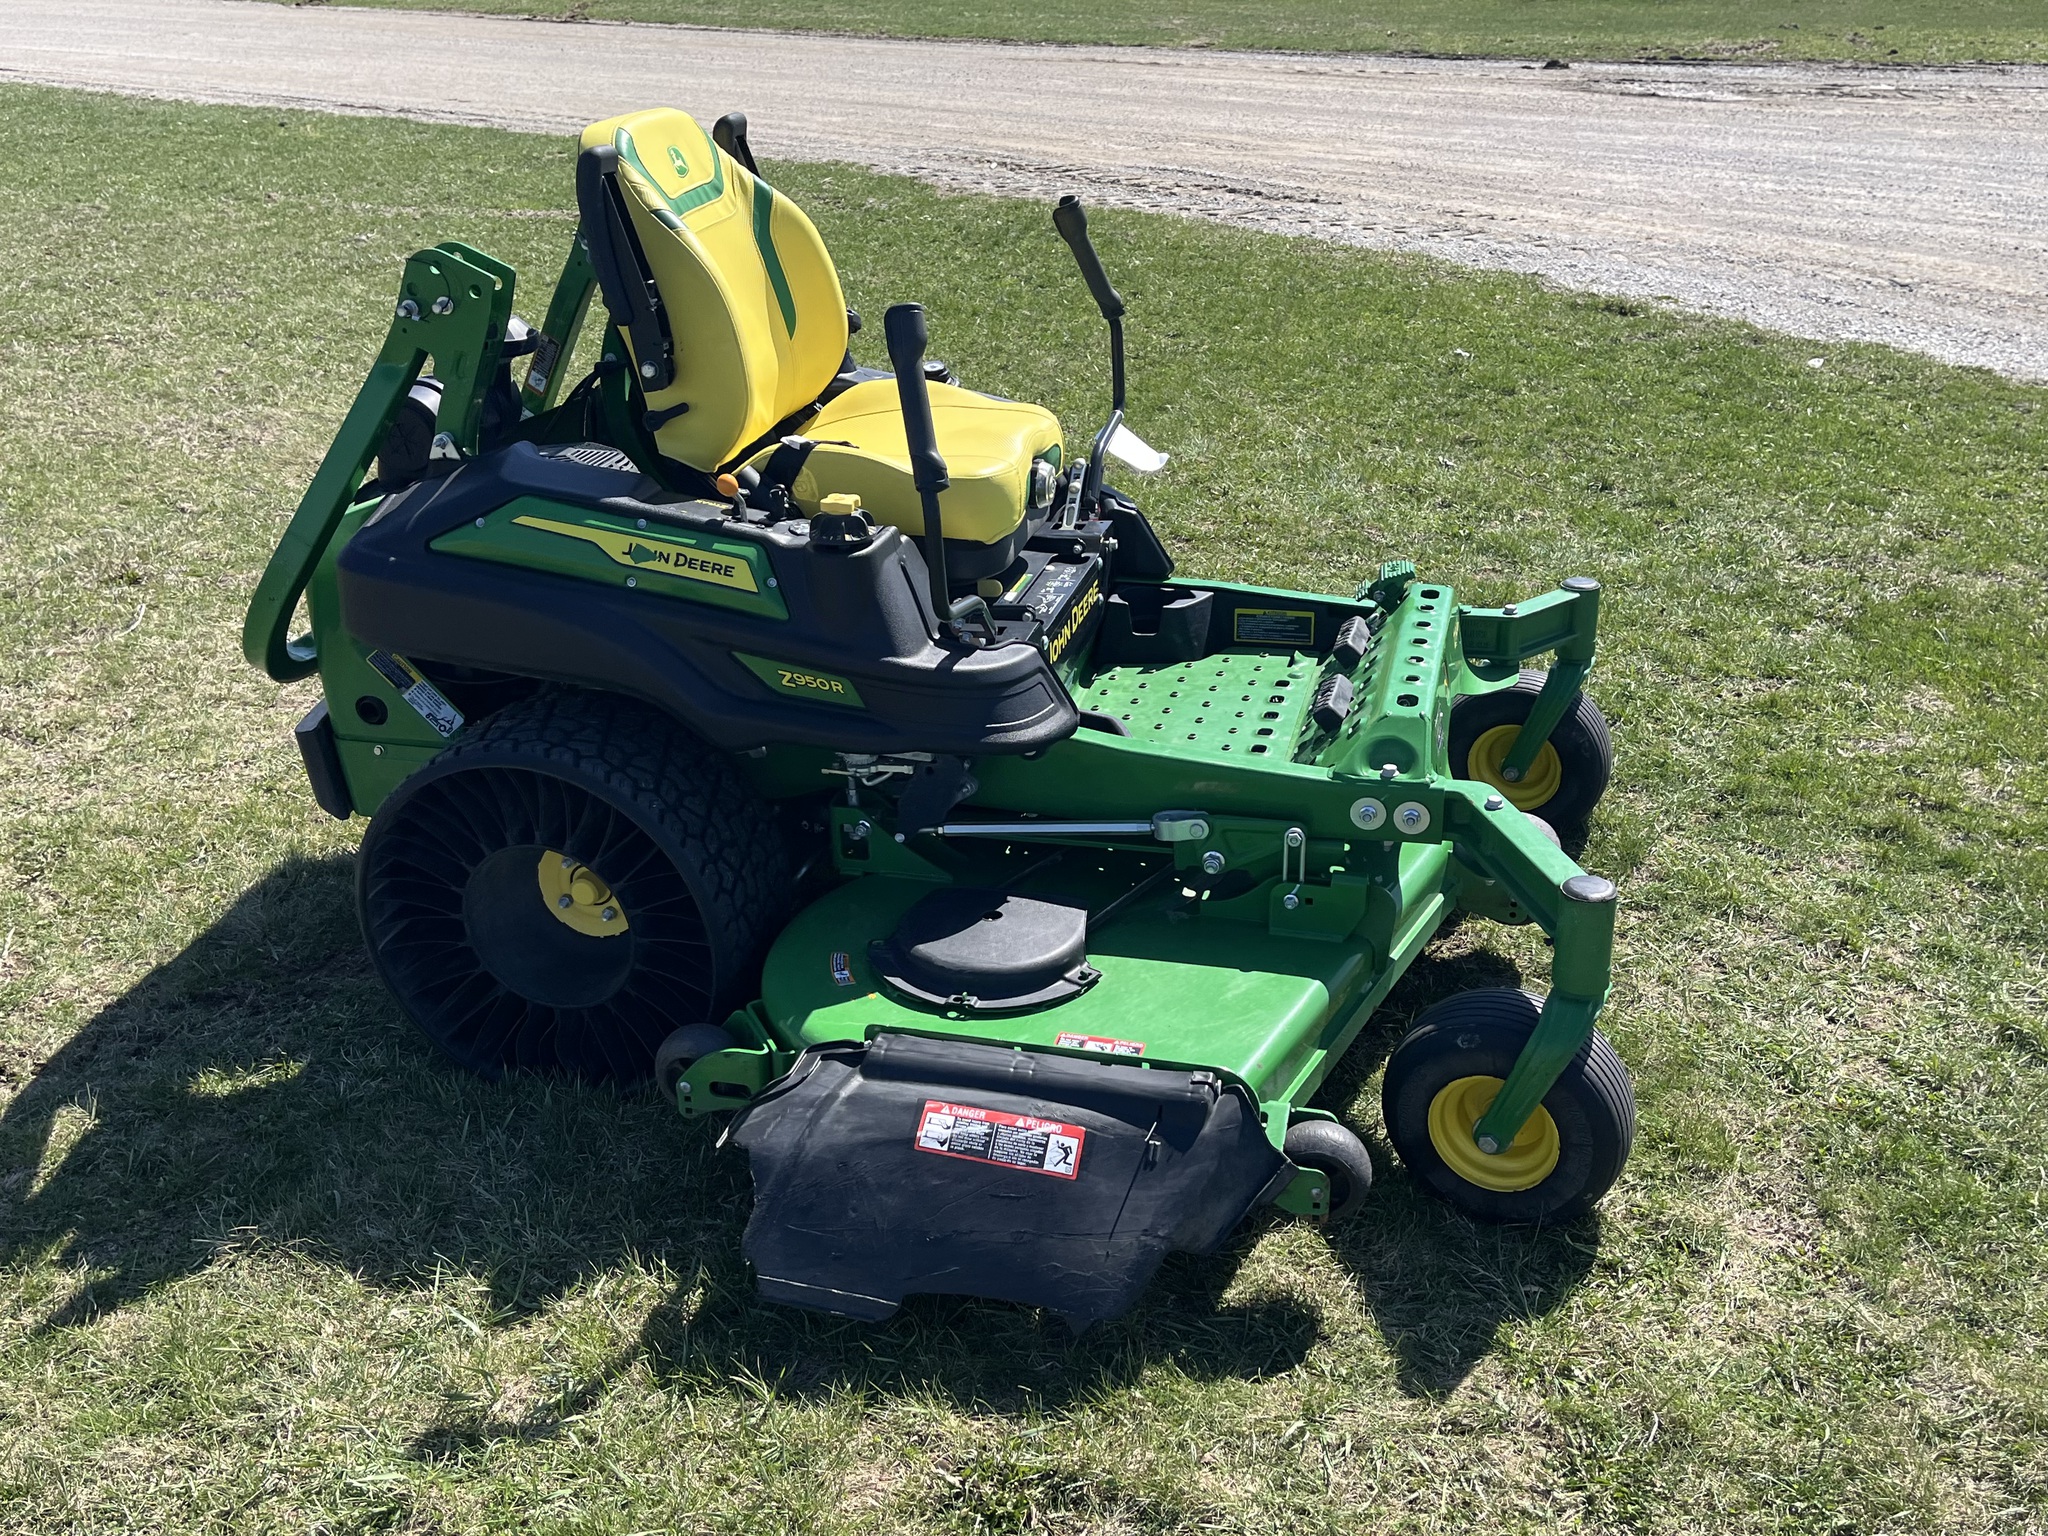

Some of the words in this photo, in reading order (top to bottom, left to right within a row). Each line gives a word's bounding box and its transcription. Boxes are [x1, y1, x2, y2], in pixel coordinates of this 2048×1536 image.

[674, 552, 735, 578] DEERE
[1071, 579, 1099, 634] DEERE
[951, 1106, 986, 1120] DANGER
[1025, 1118, 1063, 1134] PELIGRO
